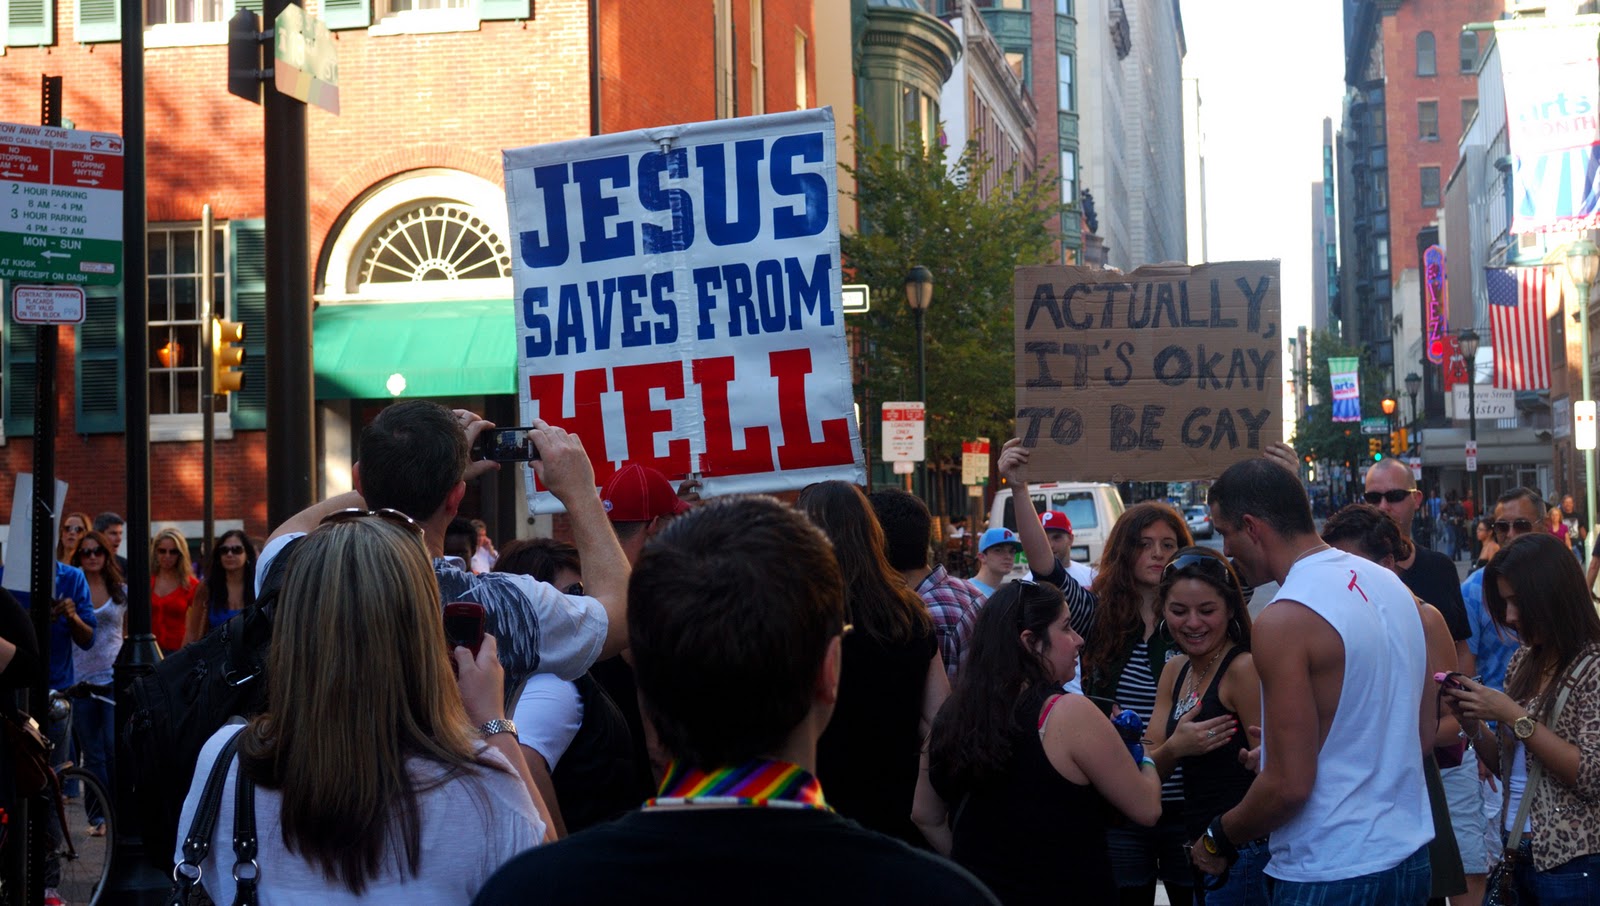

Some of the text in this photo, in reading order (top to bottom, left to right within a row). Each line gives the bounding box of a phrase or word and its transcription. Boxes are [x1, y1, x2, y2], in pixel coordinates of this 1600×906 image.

[20, 126, 40, 136] AWAY
[45, 129, 68, 139] ZONE
[8, 146, 20, 154] NO
[27, 164, 39, 172] AM
[72, 160, 105, 170] STOPPING
[73, 168, 103, 177] ANYTIME
[12, 183, 88, 200] 2 HOUR PARKING
[28, 199, 34, 208] 8
[37, 201, 50, 209] AM
[70, 203, 83, 212] PM
[520, 132, 829, 268] JESUS
[11, 208, 87, 224] 3 HOUR PARKING
[26, 224, 32, 232] 4
[35, 224, 48, 232] PM
[60, 226, 68, 235] 12
[71, 227, 84, 236] AM
[23, 236, 47, 248] MON
[60, 239, 82, 250] SUN
[1, 258, 36, 268] AT KIOSK
[18, 269, 50, 279] RECEIPT
[52, 272, 64, 280] ON
[66, 273, 88, 282] DASH
[18, 291, 80, 299] CONTRACTOR PARKING
[523, 253, 835, 358] SAVES FROM
[1025, 274, 1276, 340] ACTUALLY,
[1024, 339, 1276, 391] IT'S OKAY
[1334, 381, 1355, 390] arts
[529, 348, 854, 492] HELL
[1017, 403, 1271, 452] TO BE GAY
